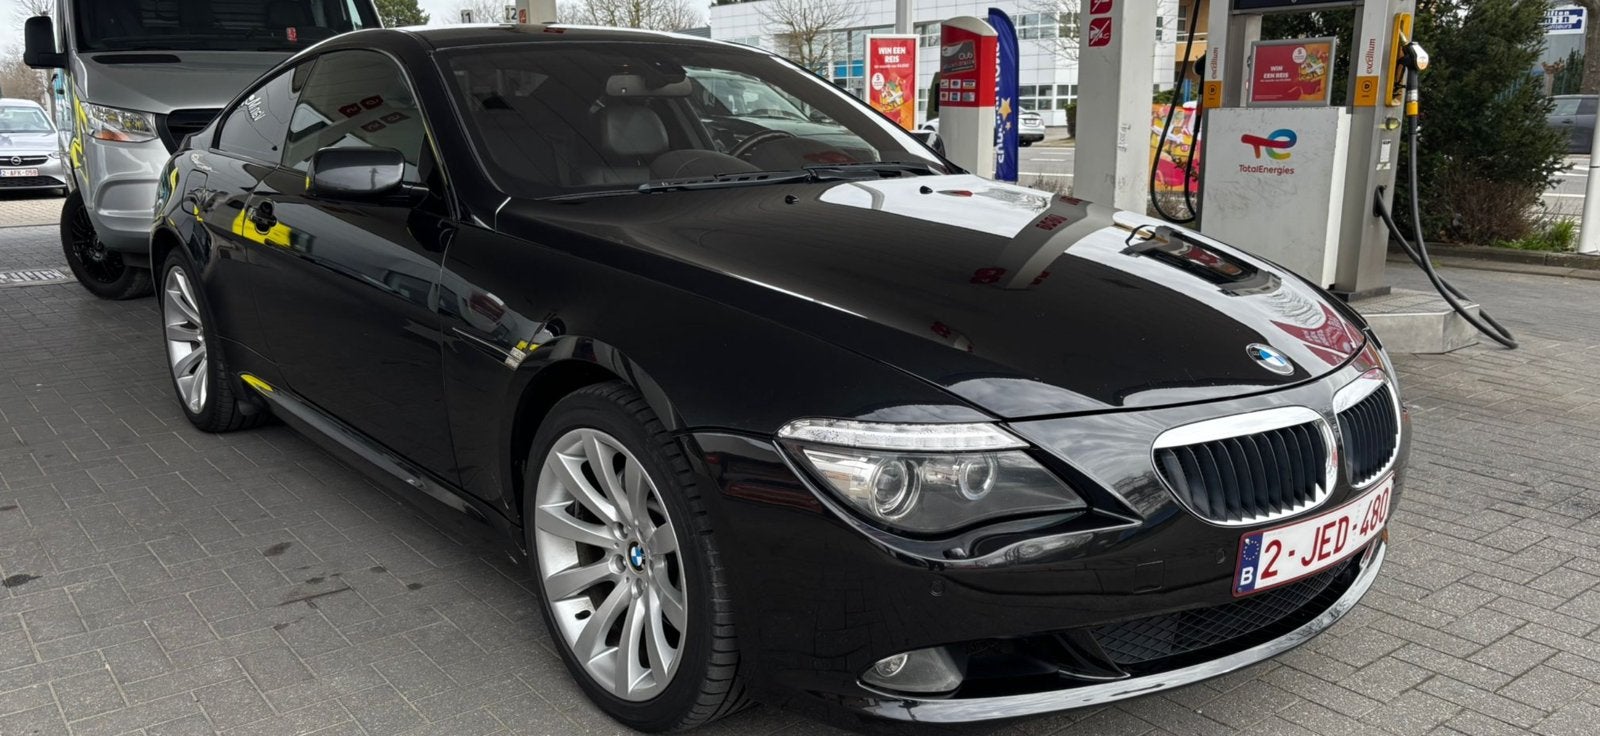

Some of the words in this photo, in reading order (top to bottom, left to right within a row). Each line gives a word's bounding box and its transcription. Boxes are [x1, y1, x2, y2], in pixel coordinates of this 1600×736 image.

[878, 47, 892, 55] WIN
[892, 46, 906, 55] EEN
[884, 55, 900, 63] REIS
[1239, 164, 1295, 176] TotalEnergies
[1260, 487, 1390, 581] 2-JED-480
[1239, 566, 1254, 586] B
